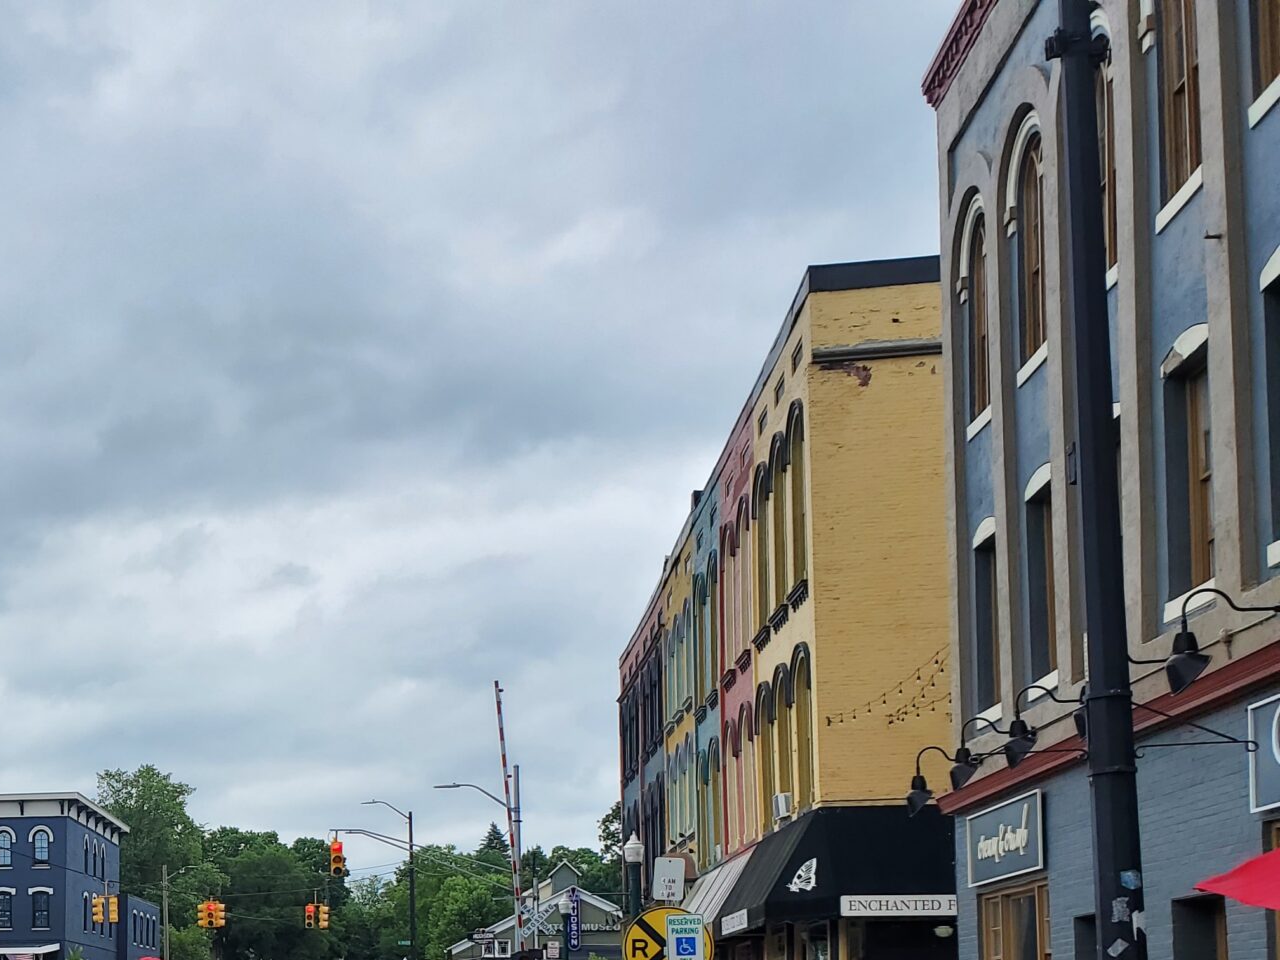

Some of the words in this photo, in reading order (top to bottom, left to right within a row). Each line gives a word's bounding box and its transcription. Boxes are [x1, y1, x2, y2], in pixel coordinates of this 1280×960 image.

[848, 900, 941, 911] ENCHANTED
[522, 903, 554, 935] CROSSING
[570, 901, 578, 946] HUDSON
[668, 918, 701, 926] RESERVED
[671, 927, 699, 935] PARKING
[632, 938, 649, 958] R
